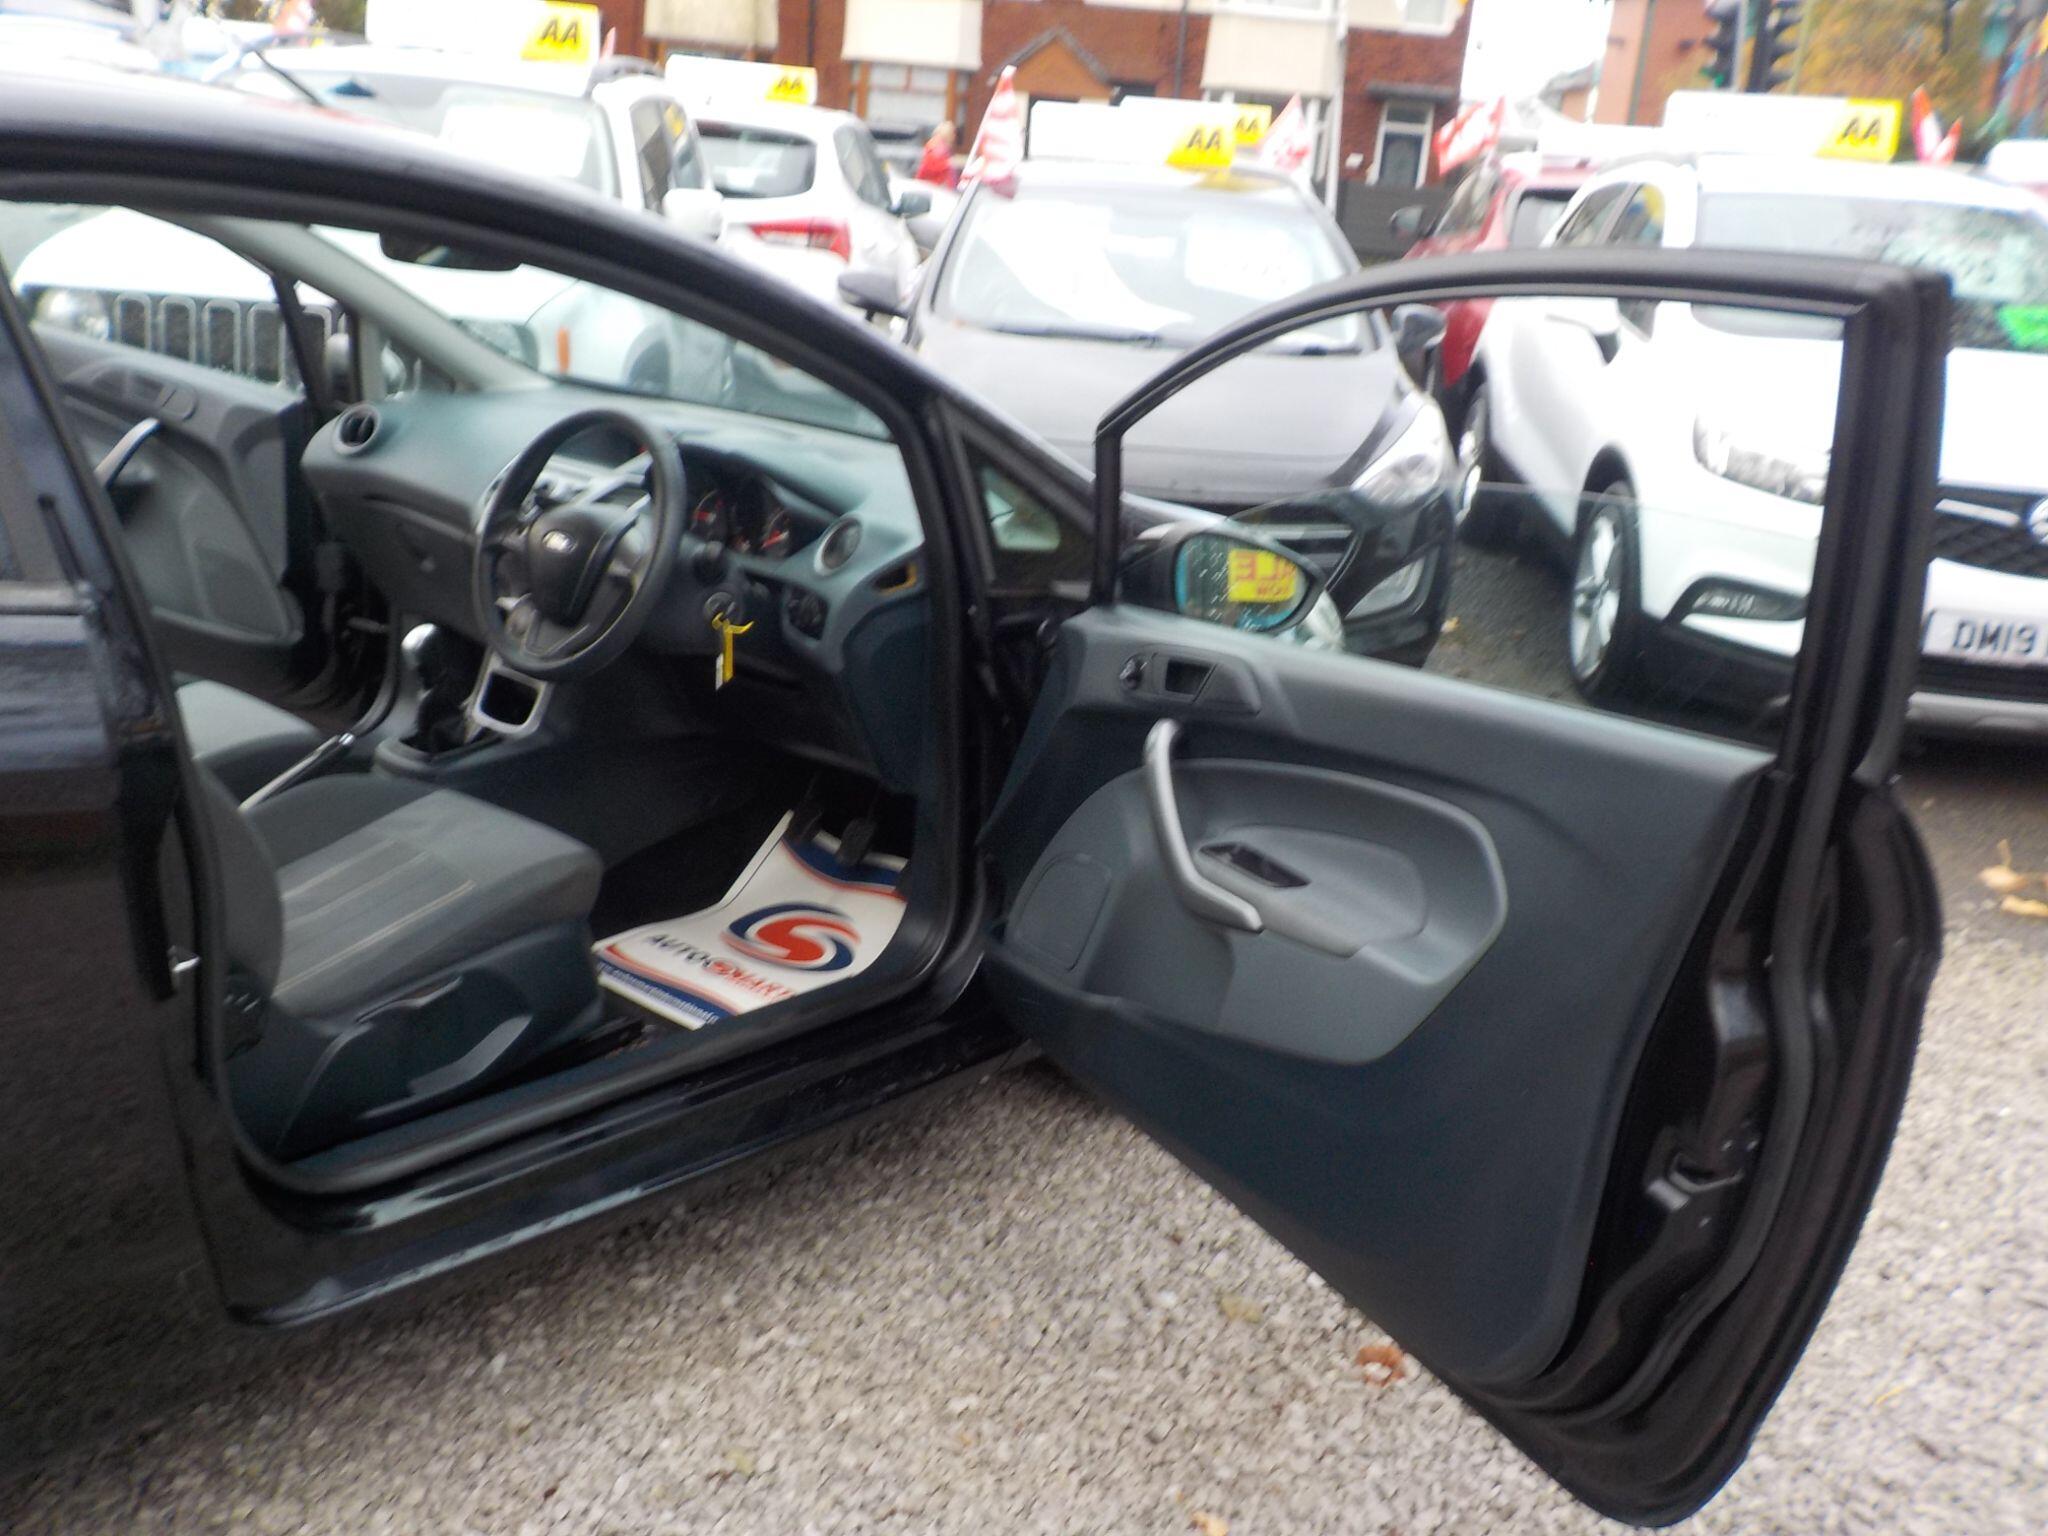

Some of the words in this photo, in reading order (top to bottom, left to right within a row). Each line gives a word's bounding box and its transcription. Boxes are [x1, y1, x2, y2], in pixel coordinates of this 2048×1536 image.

[540, 18, 579, 45] AA
[776, 76, 802, 91] AA
[1234, 116, 1259, 134] AA
[1840, 117, 1881, 144] AA
[1185, 128, 1222, 152] AA
[1952, 619, 2039, 654] DM19
